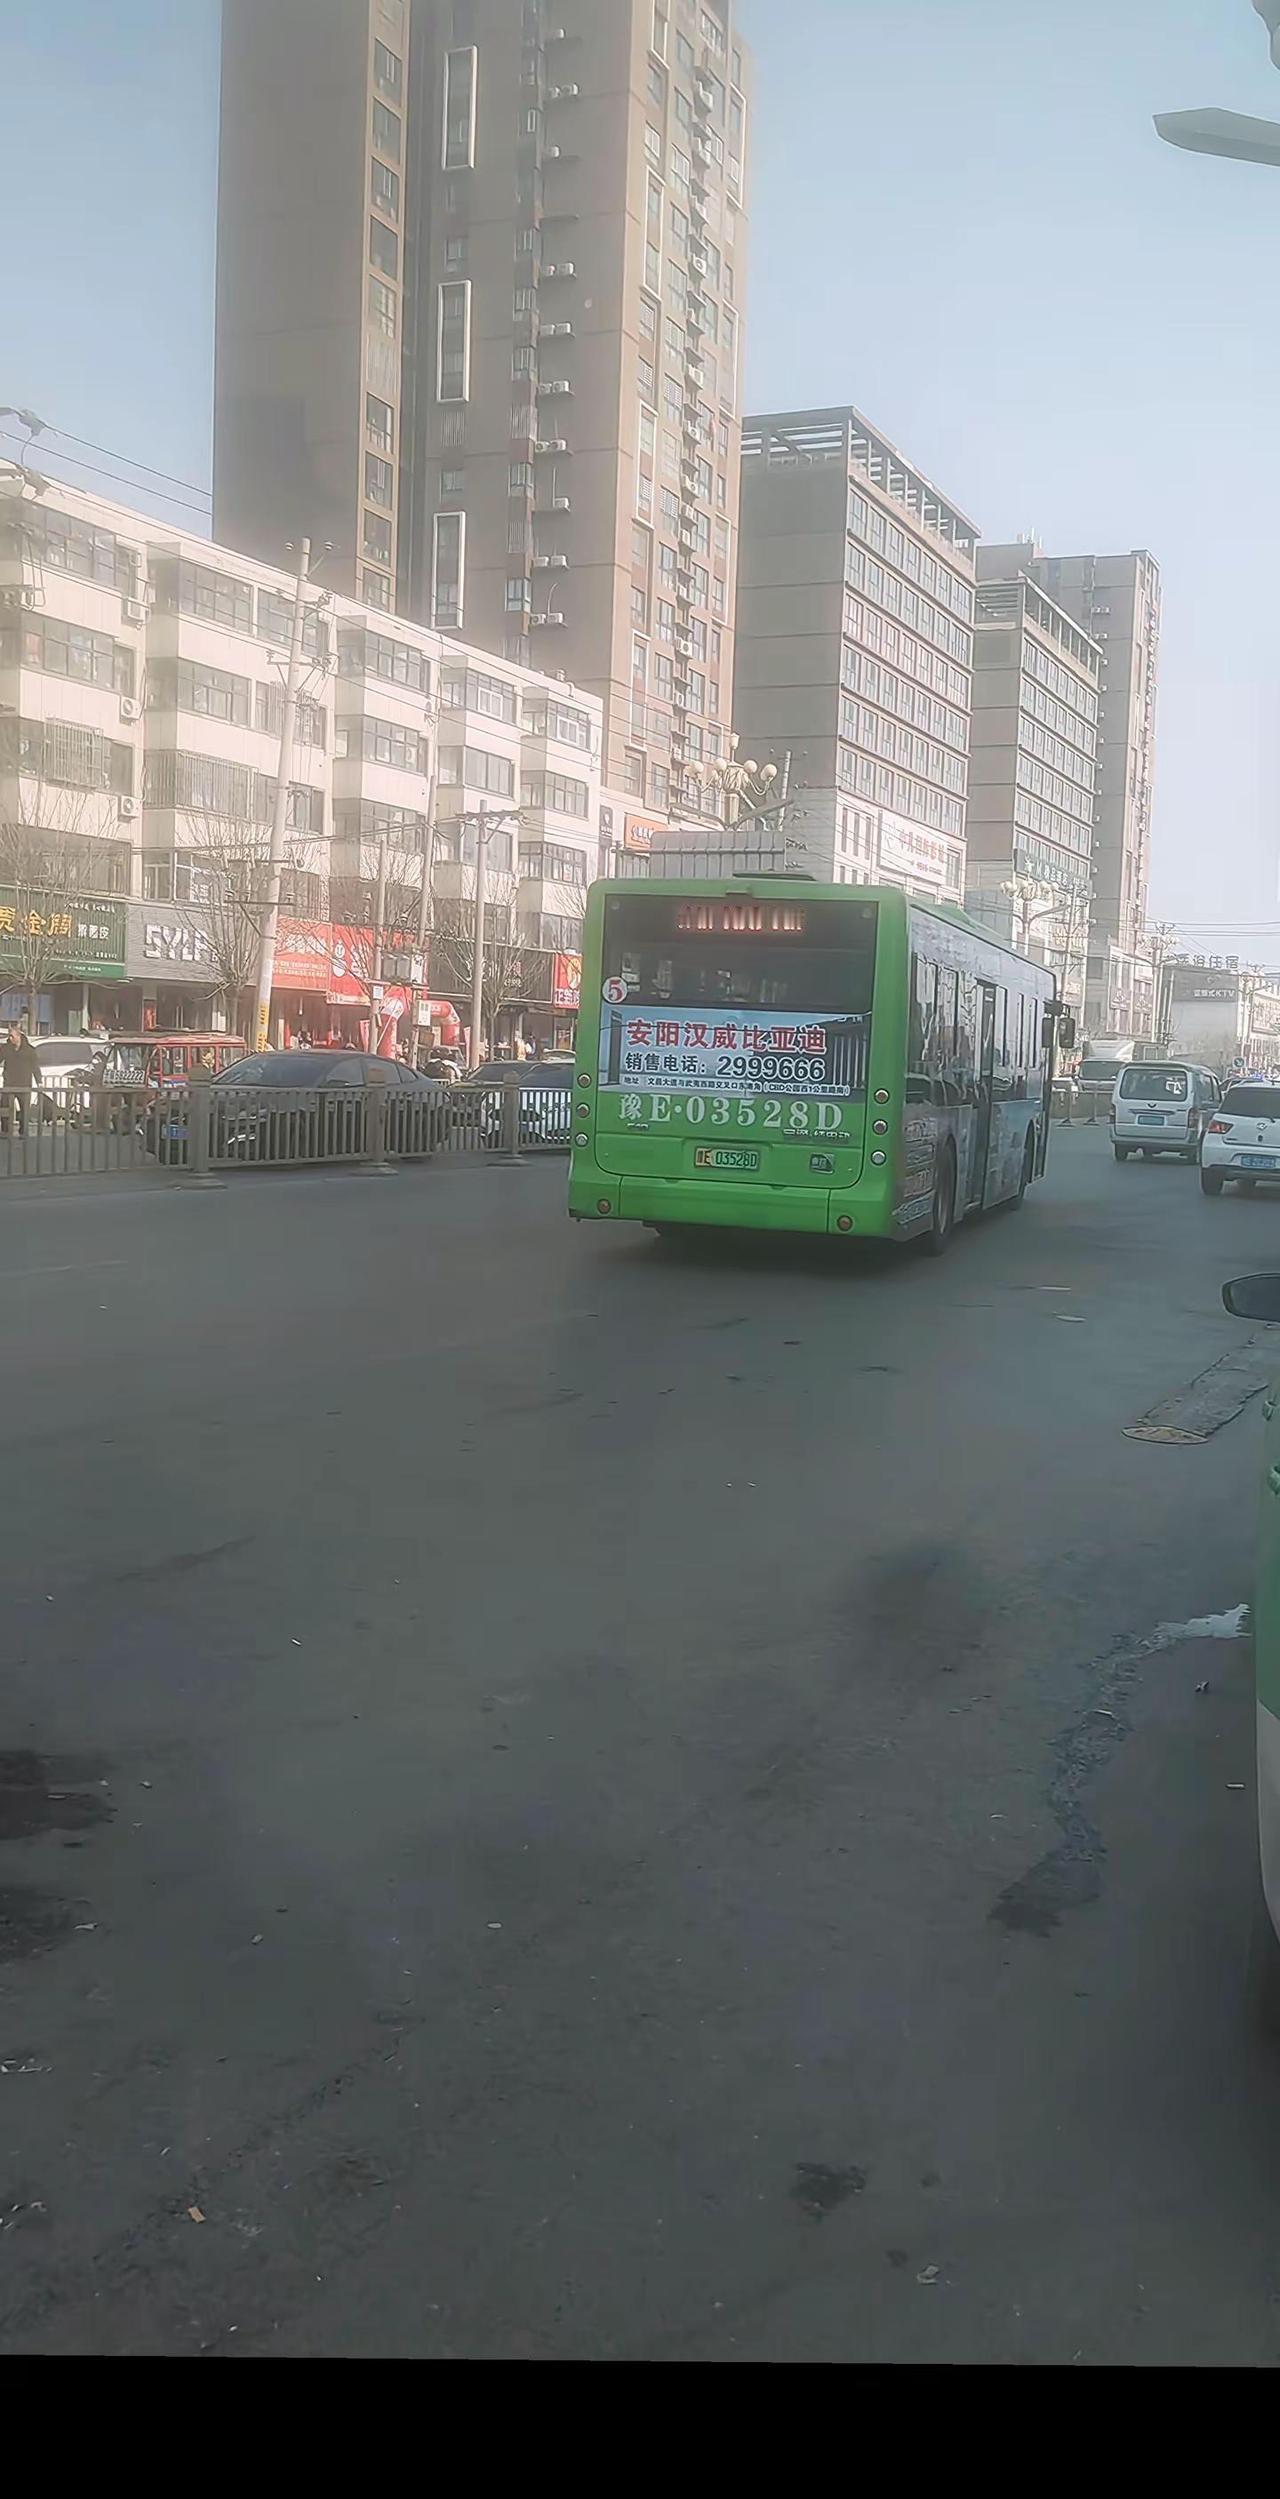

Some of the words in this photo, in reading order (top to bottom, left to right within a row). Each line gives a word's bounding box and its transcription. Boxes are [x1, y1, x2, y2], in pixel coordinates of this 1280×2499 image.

[608, 979, 623, 1001] 5
[626, 1018, 827, 1055] 安阳汉威比亚迪
[717, 1055, 826, 1081] 2999666
